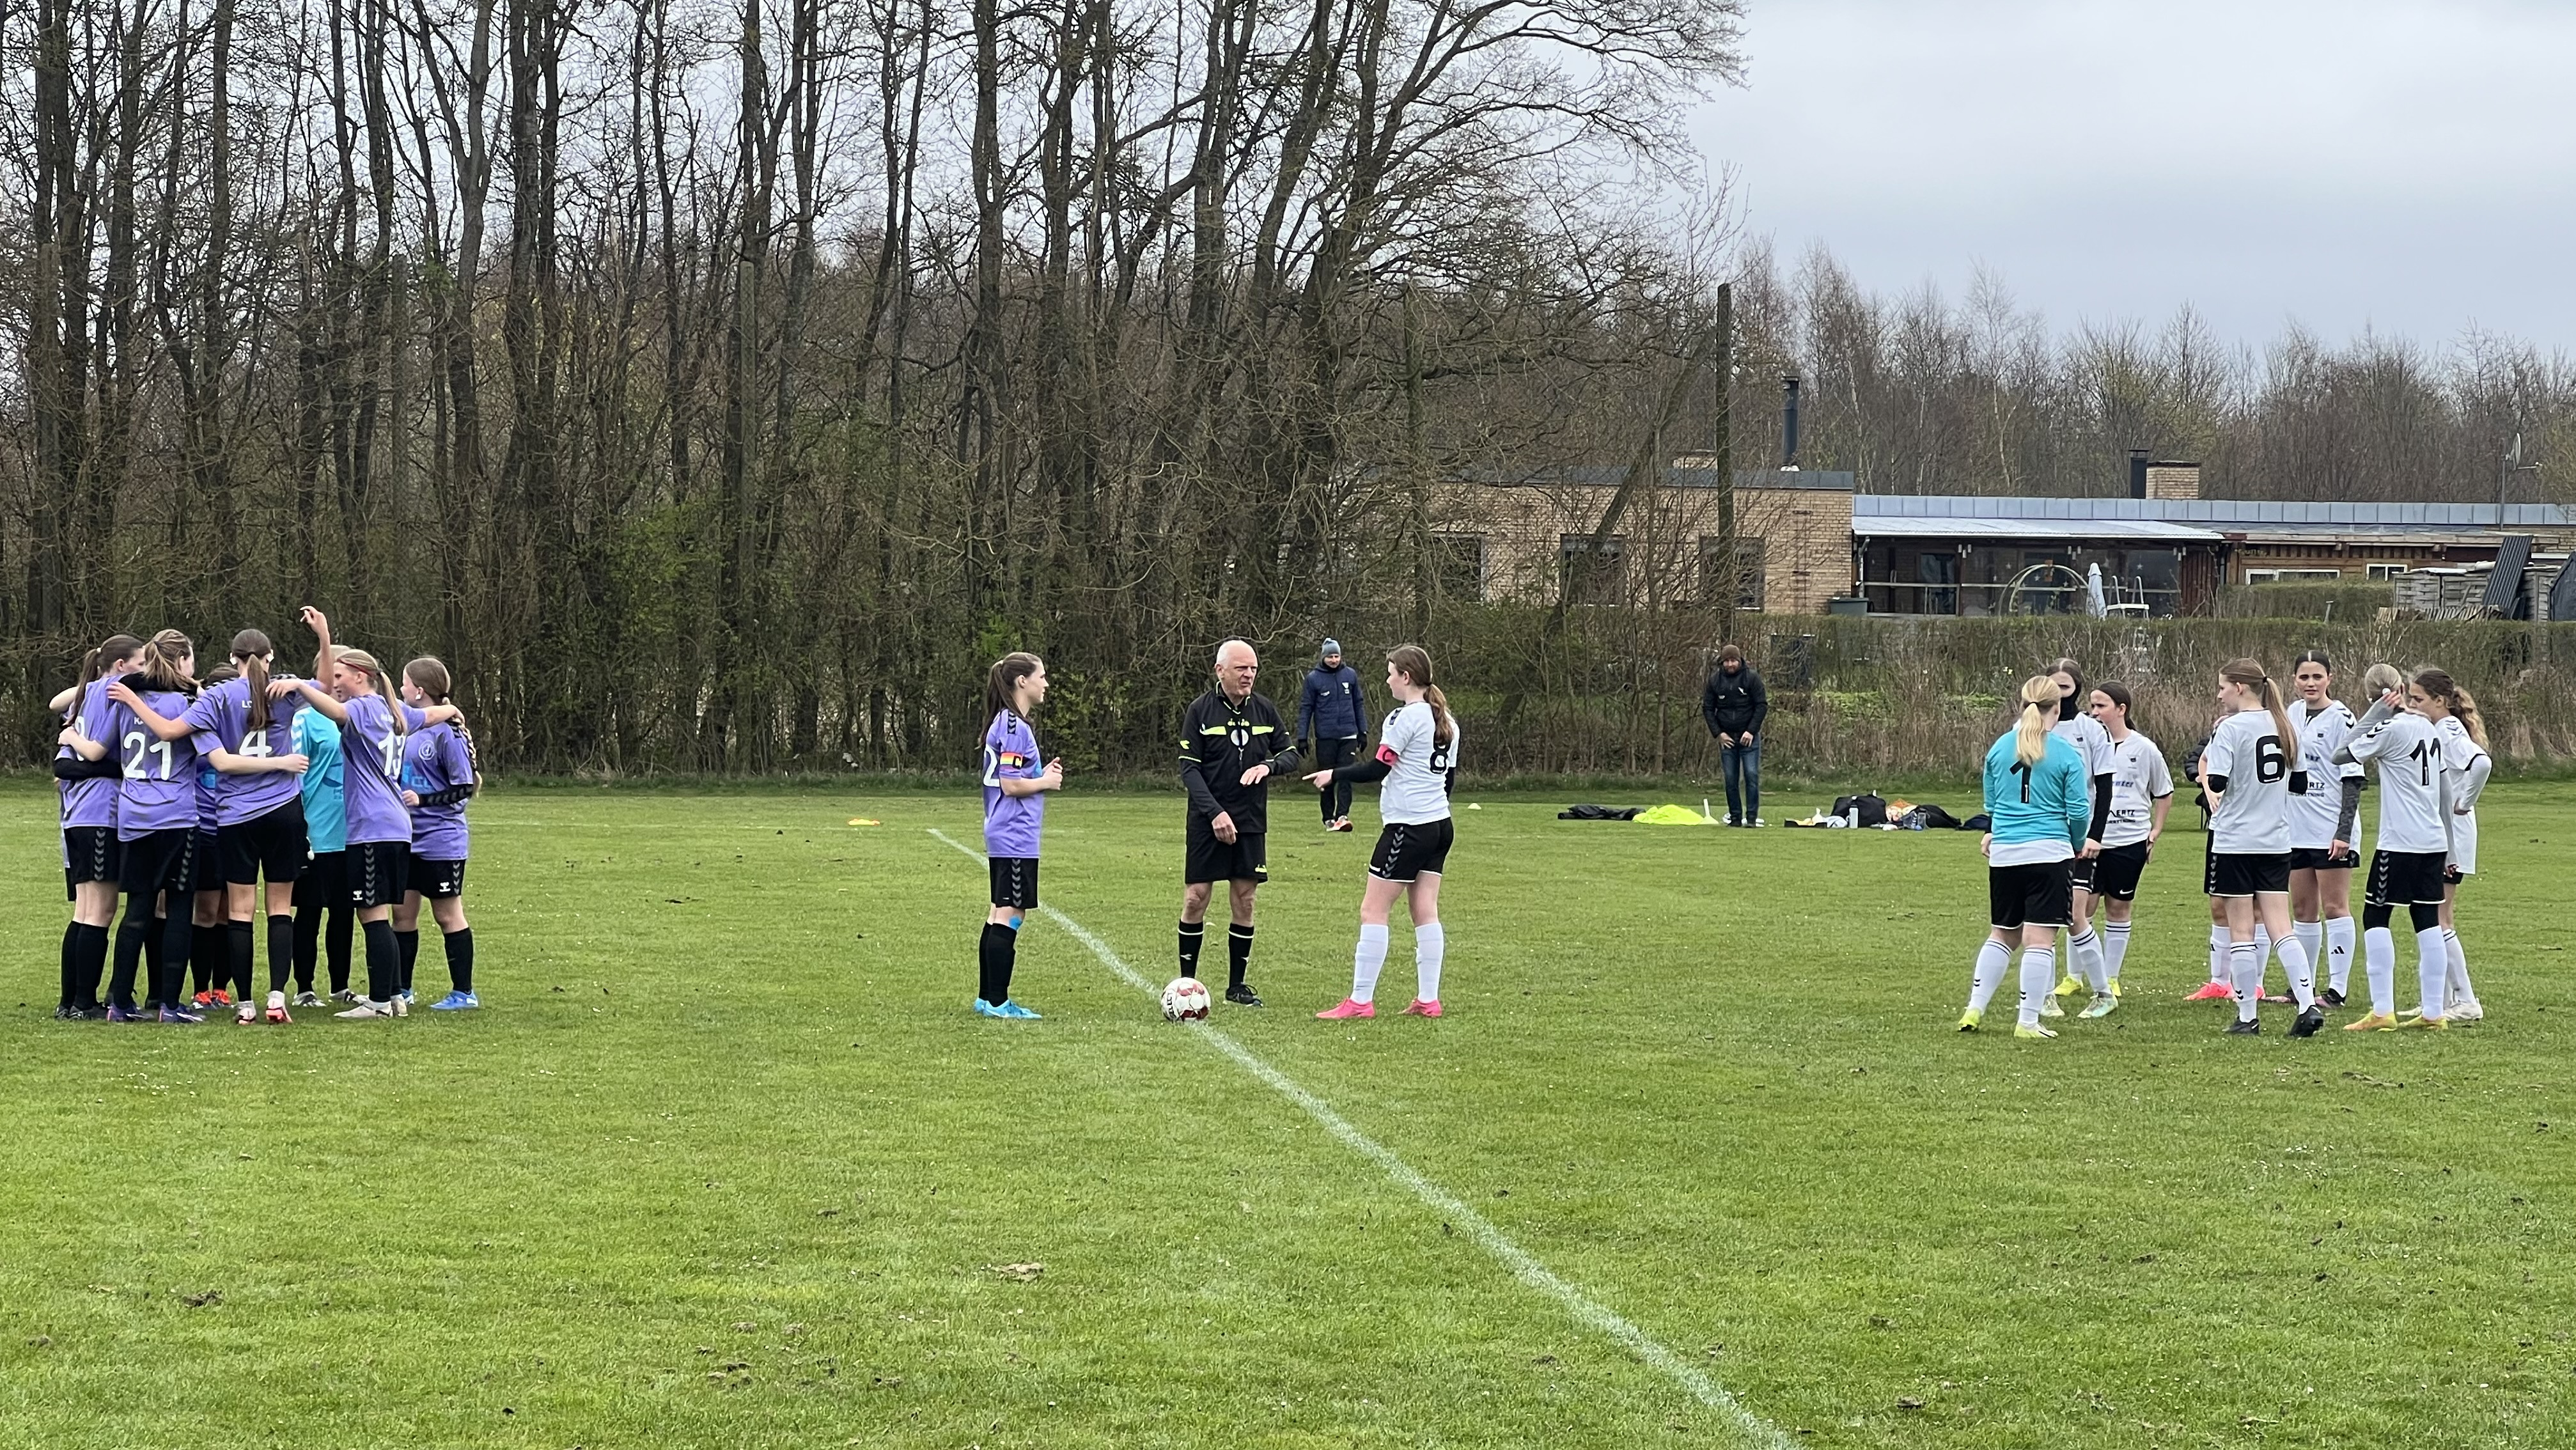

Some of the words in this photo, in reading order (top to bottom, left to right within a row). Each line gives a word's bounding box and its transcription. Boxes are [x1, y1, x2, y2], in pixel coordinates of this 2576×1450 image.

[123, 731, 171, 781] 21
[239, 729, 272, 758] 4
[378, 731, 407, 780] 13
[1012, 756, 1022, 770] C
[1382, 749, 1394, 762] C
[1430, 730, 1451, 774] 8
[2256, 735, 2286, 784] 6
[2409, 738, 2441, 786] 11
[2010, 761, 2032, 804] 1
